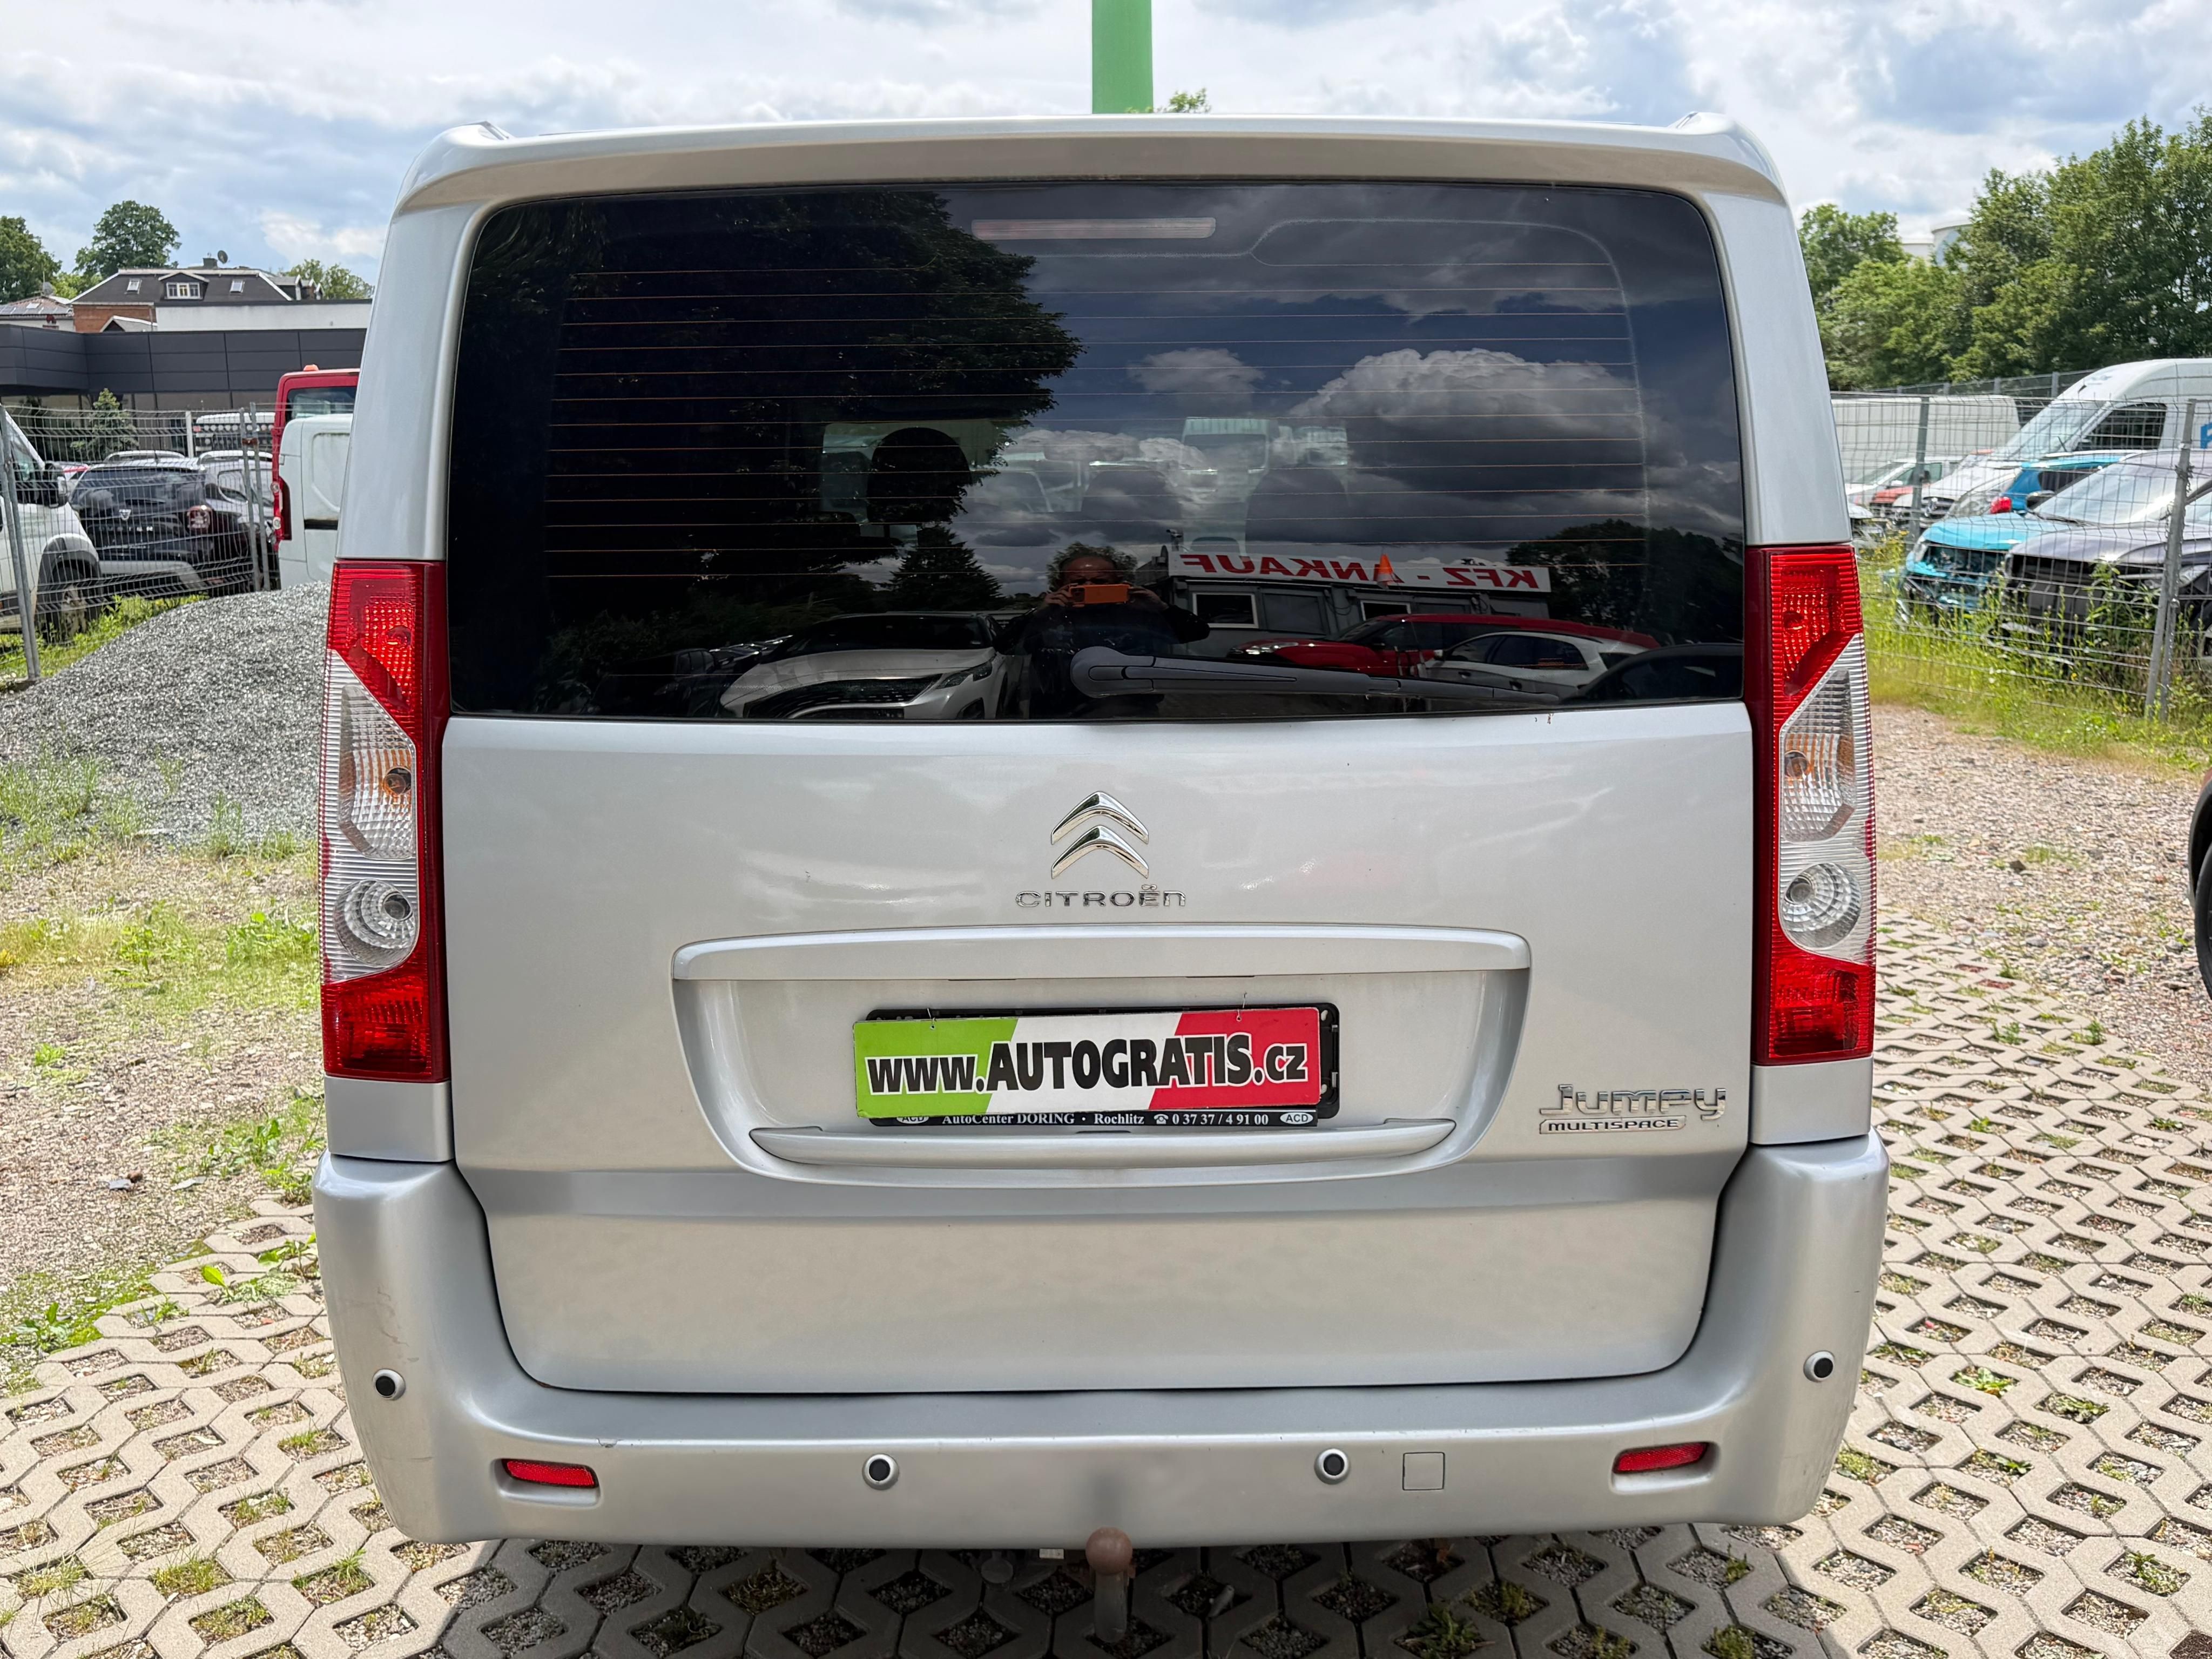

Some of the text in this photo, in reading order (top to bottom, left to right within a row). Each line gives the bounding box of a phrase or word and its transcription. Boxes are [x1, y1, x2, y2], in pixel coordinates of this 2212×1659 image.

[1539, 1084, 1727, 1121] Jumpy
[942, 1114, 1014, 1124] AutoCenter
[1094, 1113, 1144, 1125] Rochlitz
[1172, 1114, 1179, 1125] 0
[1182, 1114, 1196, 1125] 37
[1200, 1114, 1215, 1124] 37
[1225, 1114, 1233, 1124] 4
[1236, 1114, 1250, 1124] 91
[1254, 1114, 1269, 1124] 00
[1286, 1114, 1309, 1123] ACD
[1548, 1119, 1679, 1132] MULTISPACE
